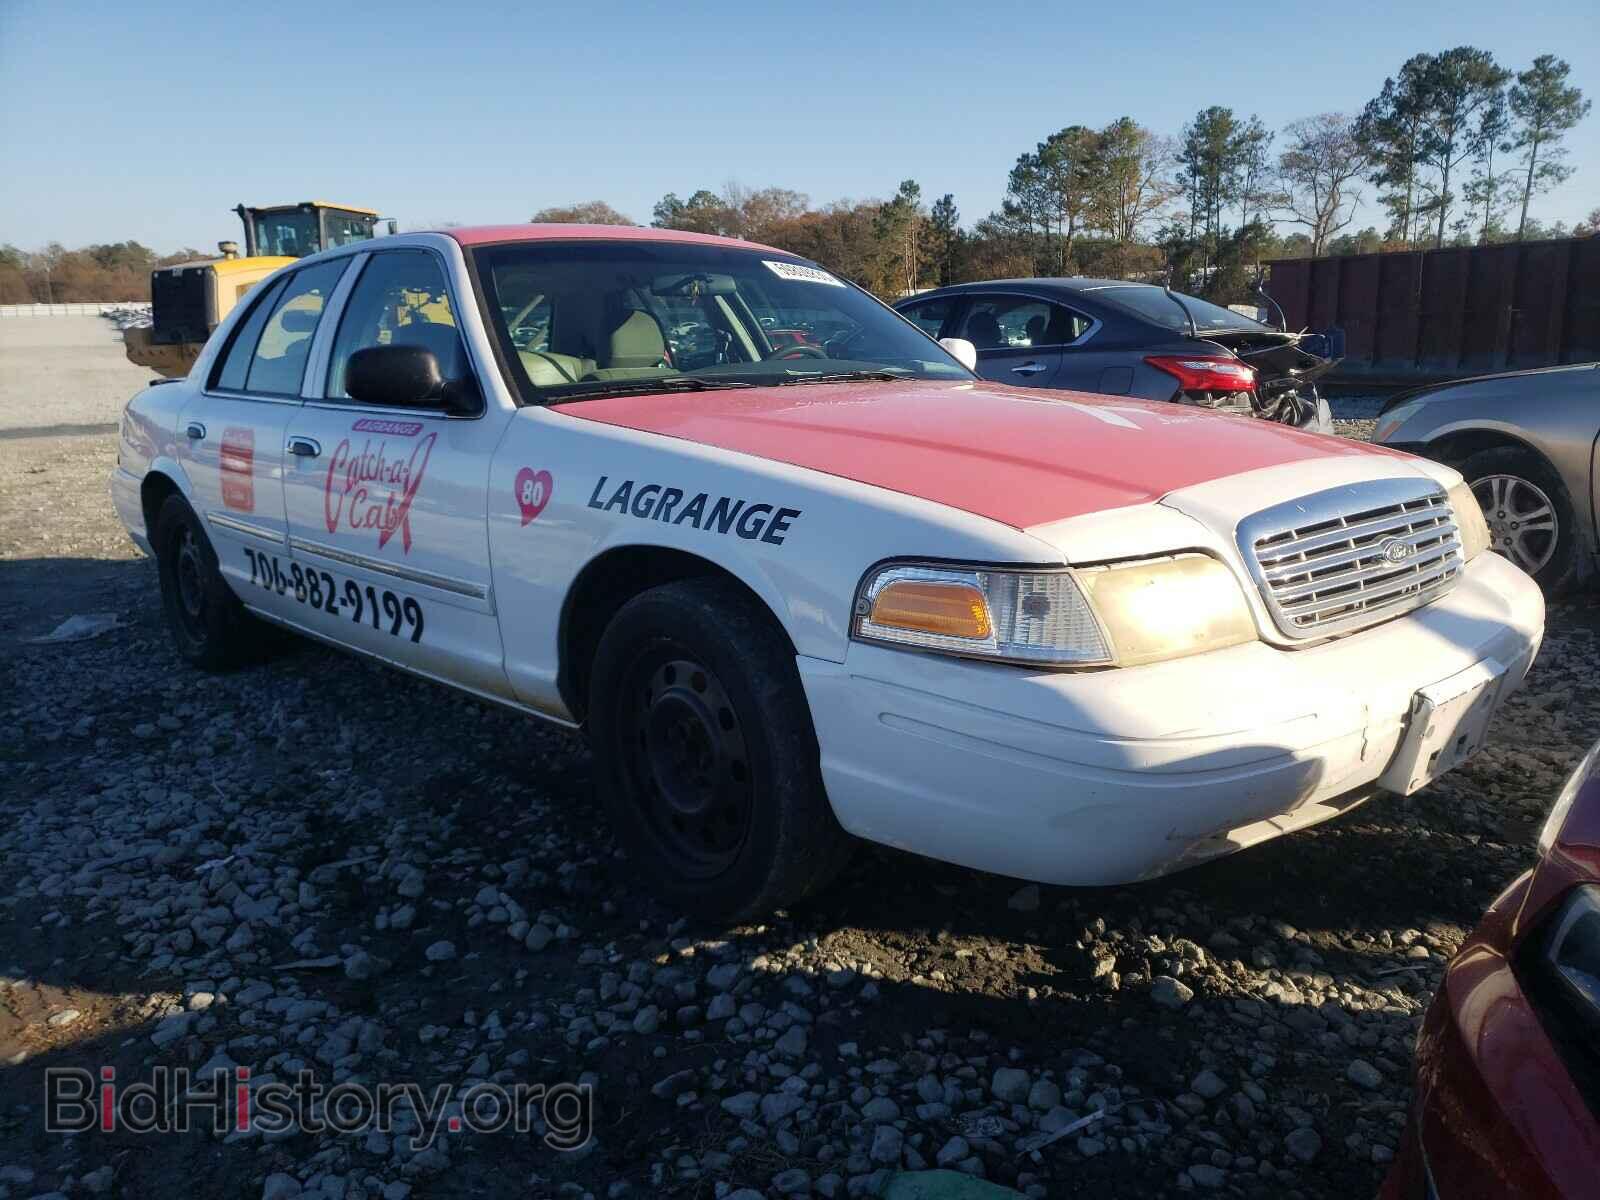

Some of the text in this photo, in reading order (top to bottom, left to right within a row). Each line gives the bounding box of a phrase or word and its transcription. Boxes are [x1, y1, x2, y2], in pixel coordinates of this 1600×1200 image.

[355, 420, 421, 435] LAGRANGE
[349, 488, 403, 531] Cab
[521, 478, 544, 508] 80
[587, 475, 803, 546] LAGRANGE
[243, 546, 425, 644] 706-882-9199
